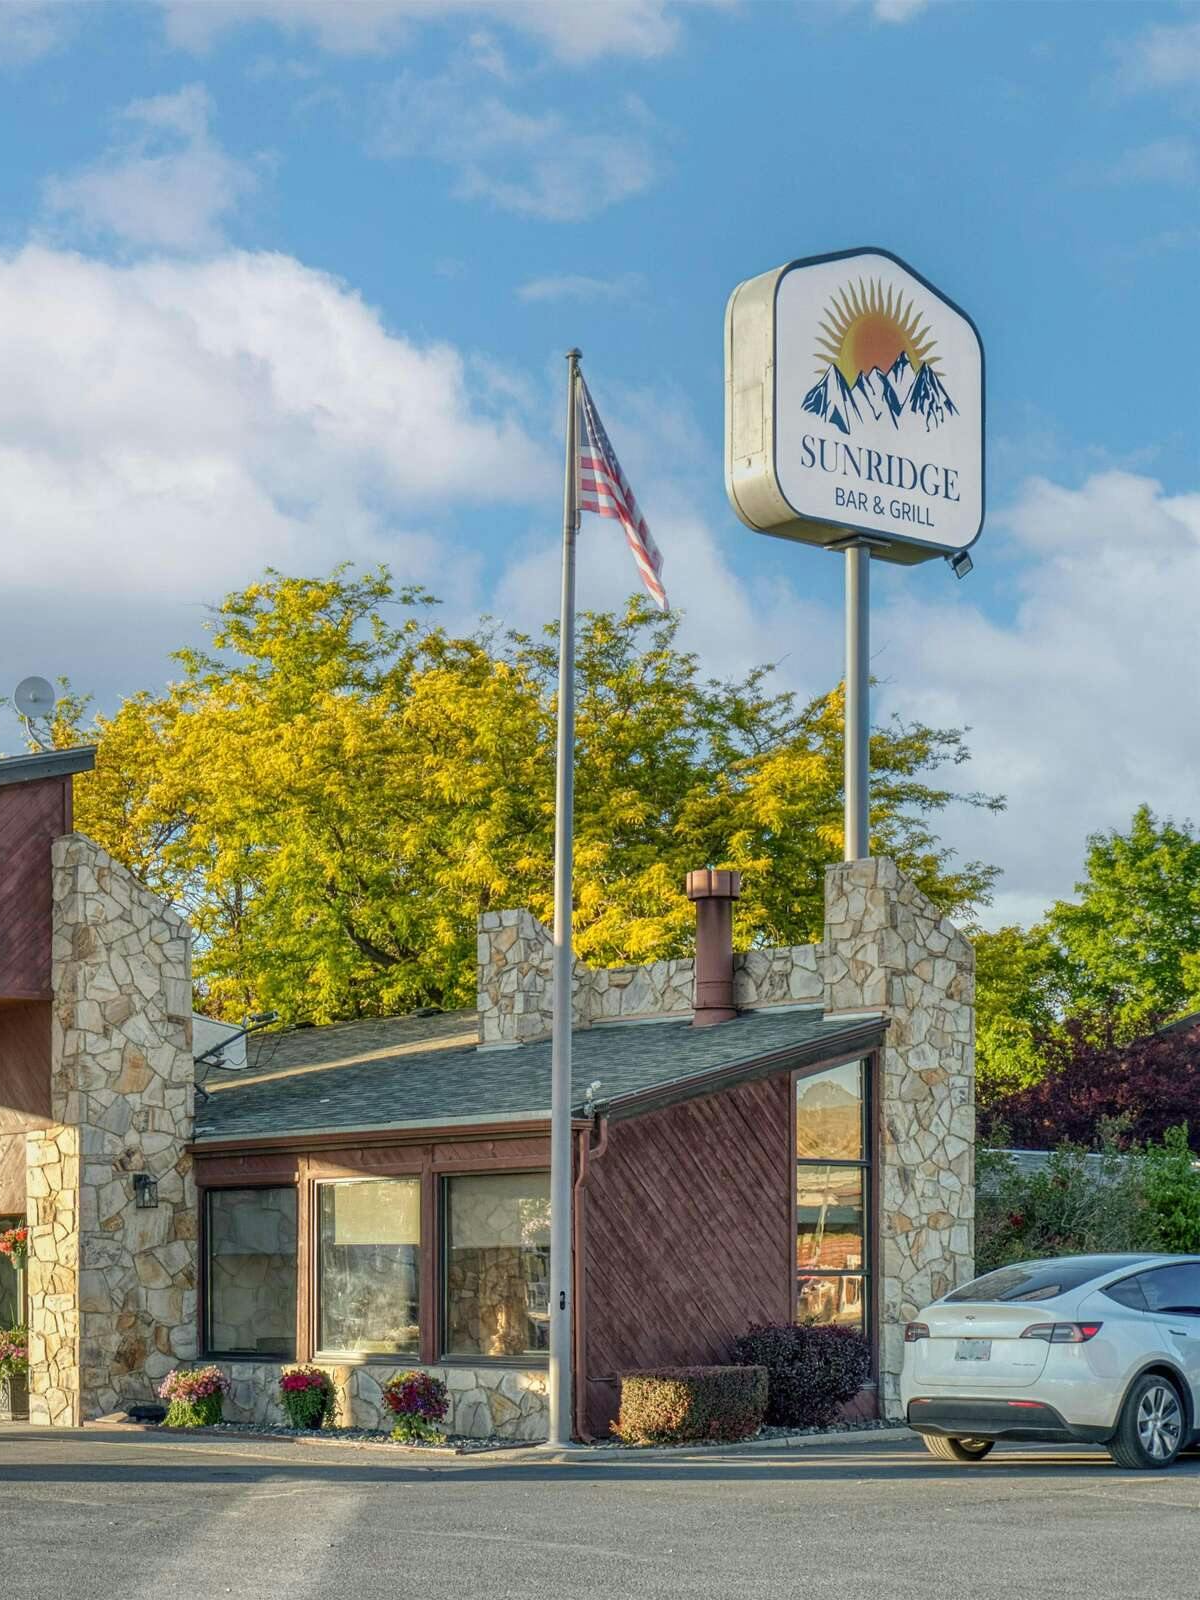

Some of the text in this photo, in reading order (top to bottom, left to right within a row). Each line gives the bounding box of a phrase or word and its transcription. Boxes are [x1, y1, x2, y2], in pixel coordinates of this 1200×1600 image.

[800, 434, 960, 501] SUNRIDGE
[835, 487, 935, 527] BAR & GRILL
